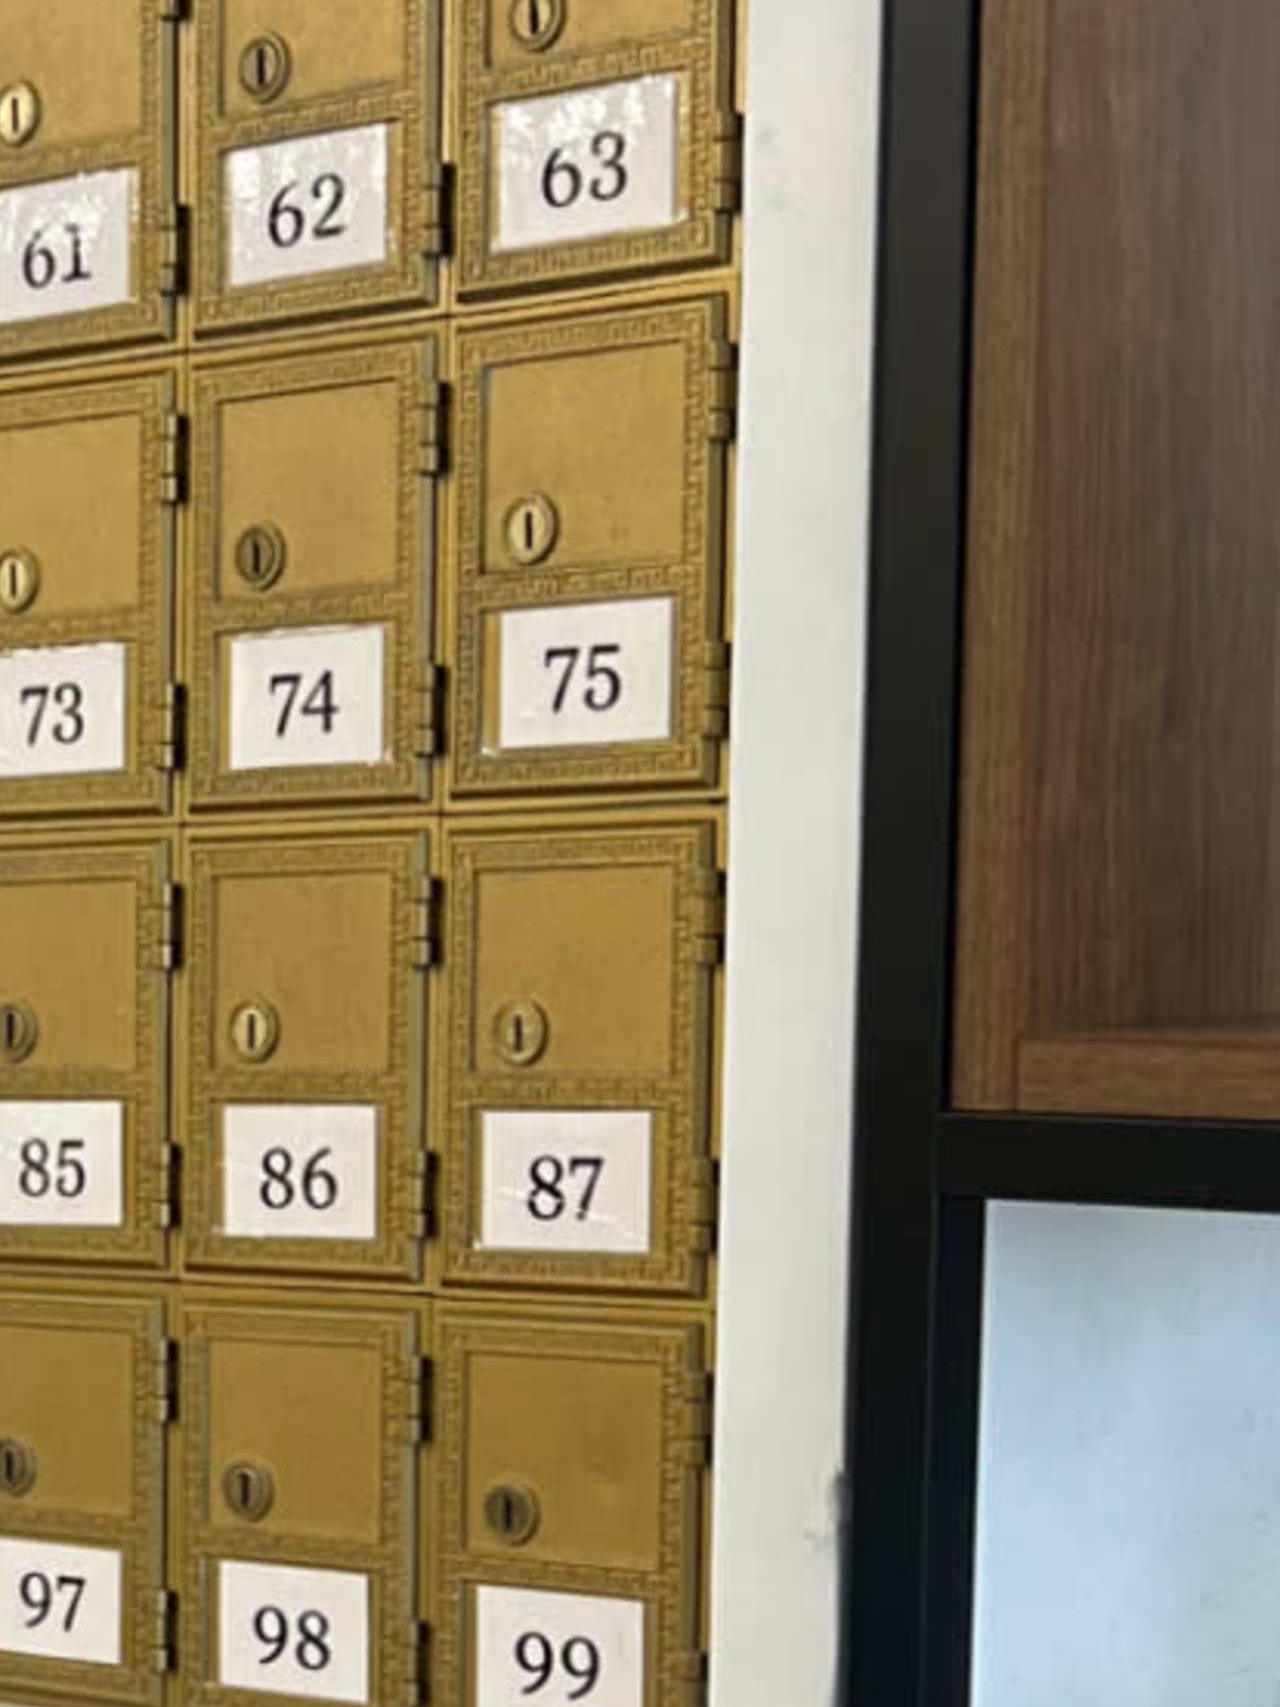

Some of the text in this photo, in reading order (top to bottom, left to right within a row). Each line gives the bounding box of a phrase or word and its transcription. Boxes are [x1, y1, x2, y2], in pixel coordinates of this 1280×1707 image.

[541, 130, 628, 209] 63
[267, 172, 345, 249] 62
[21, 223, 92, 290] 61
[269, 669, 339, 738] 74
[544, 643, 622, 714] 75
[20, 682, 85, 746] 73
[18, 1137, 86, 1199] 85
[259, 1147, 338, 1211] 86
[526, 1155, 605, 1222] 87
[19, 1571, 87, 1633] 97
[253, 1605, 331, 1671] 98
[514, 1631, 600, 1701] 99
